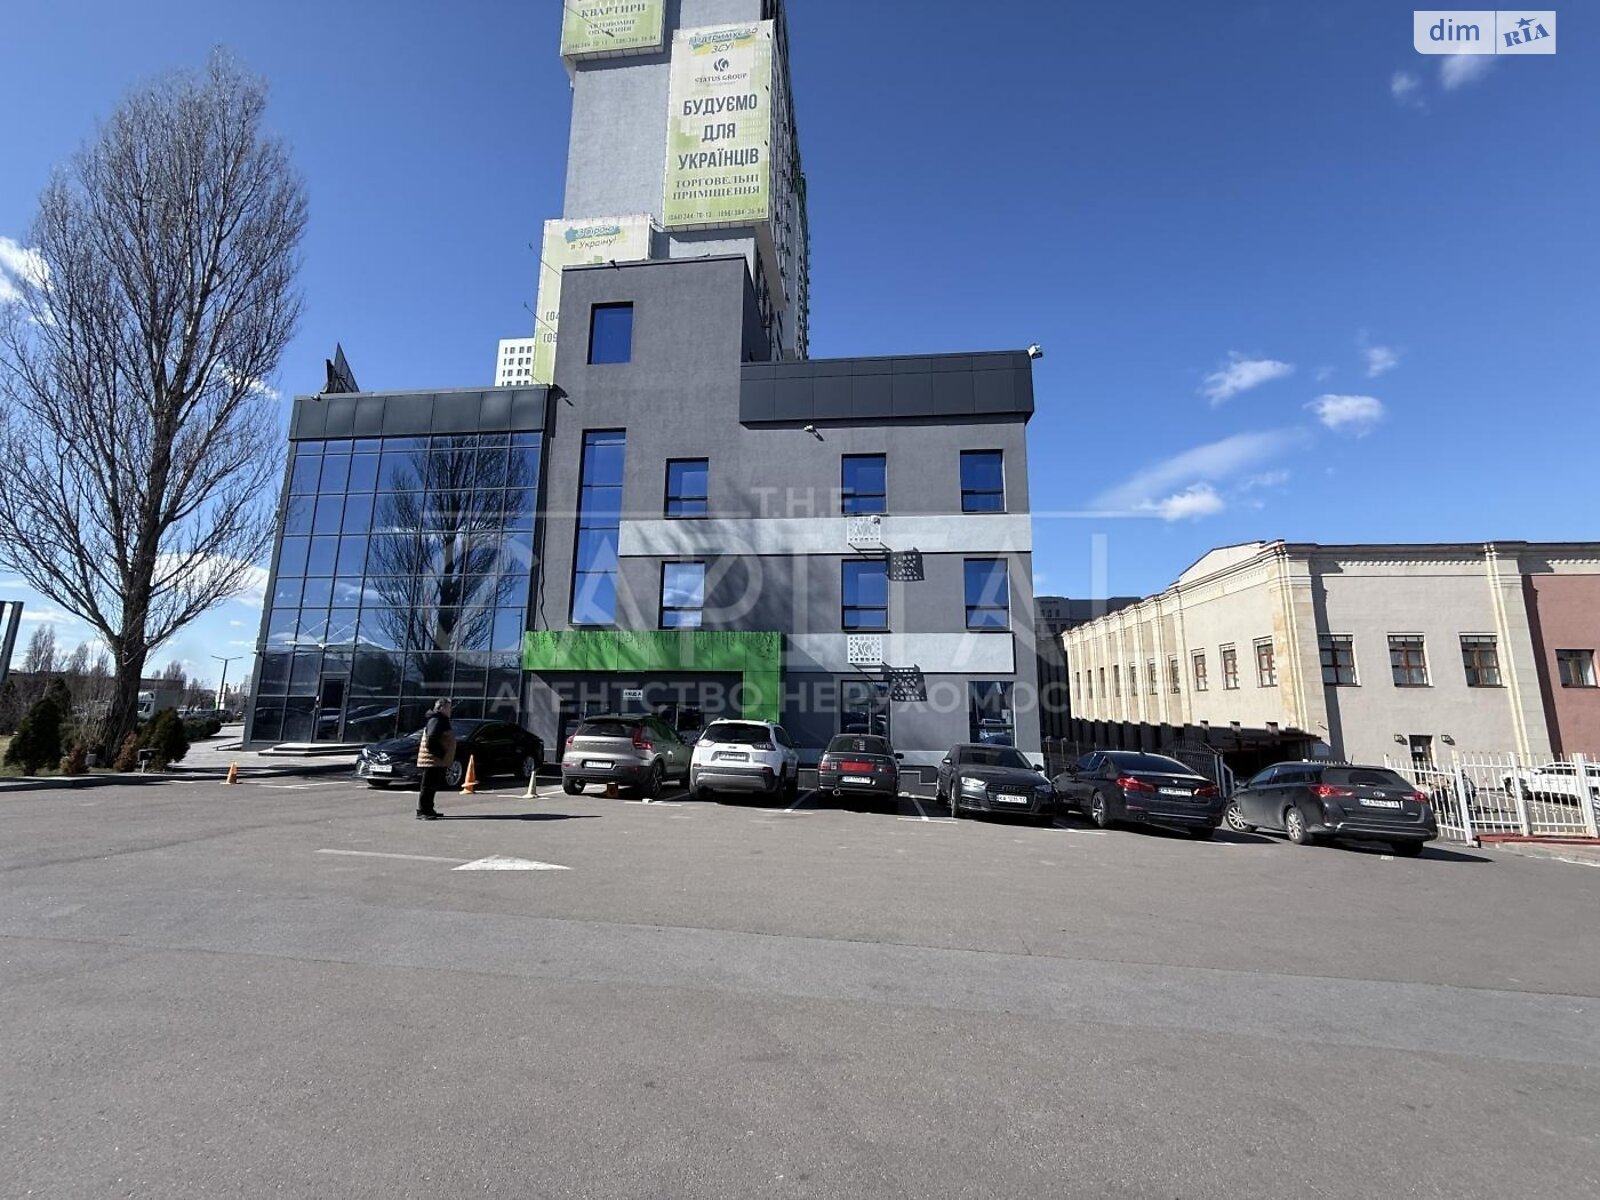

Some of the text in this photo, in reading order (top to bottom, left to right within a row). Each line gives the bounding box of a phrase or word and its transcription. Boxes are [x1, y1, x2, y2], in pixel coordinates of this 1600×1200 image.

[581, 3, 646, 18] КВАРТИРИ
[694, 75, 721, 83] STATUS
[722, 73, 748, 81] GROUP
[683, 93, 758, 116] БУДУЄМО
[701, 122, 736, 142] ДЛЯ
[677, 148, 759, 171] УКРАЇНЦІВ
[676, 174, 759, 188] ТОРГОВЕЛЬНІ
[672, 185, 760, 200] ПРИМІЩЕННЯ
[579, 235, 617, 249] Україну!
